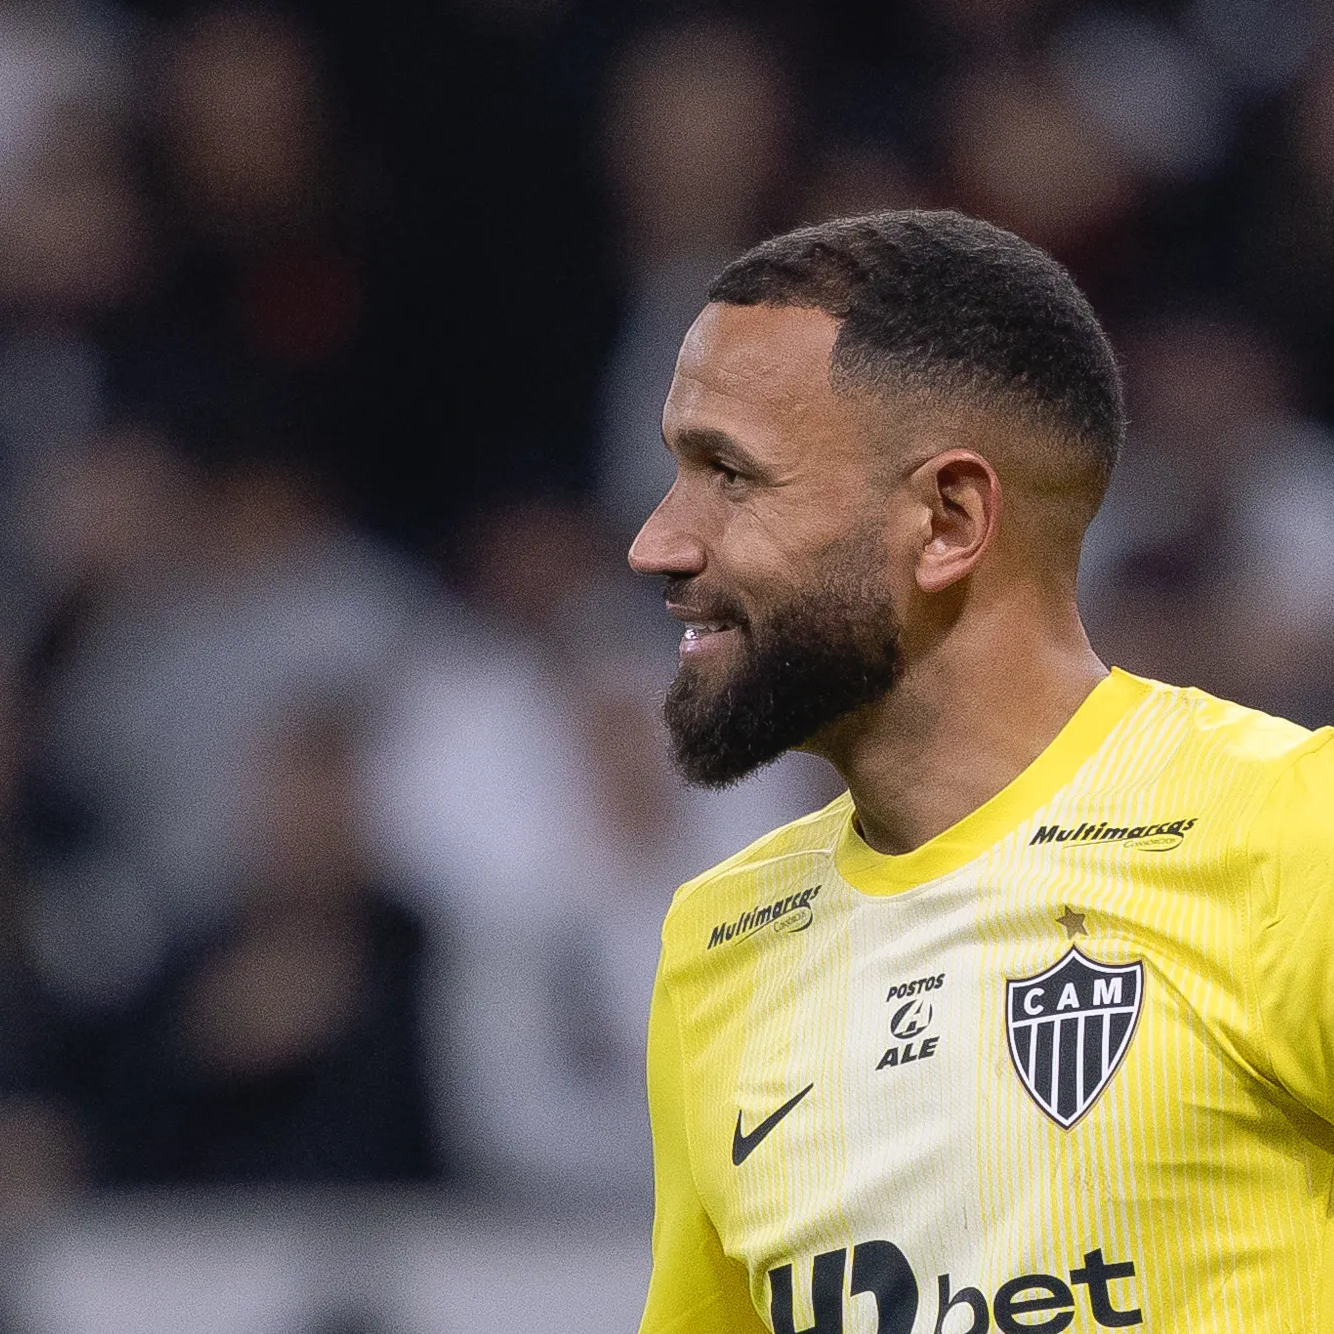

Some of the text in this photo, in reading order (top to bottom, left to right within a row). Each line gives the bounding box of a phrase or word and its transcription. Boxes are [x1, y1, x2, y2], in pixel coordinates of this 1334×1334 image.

[1028, 818, 1200, 846] Multimarcas
[707, 884, 823, 950] Multimarcas
[885, 973, 946, 1002] POSTOS
[1023, 976, 1124, 1016] CAM
[875, 1035, 941, 1071] ALE
